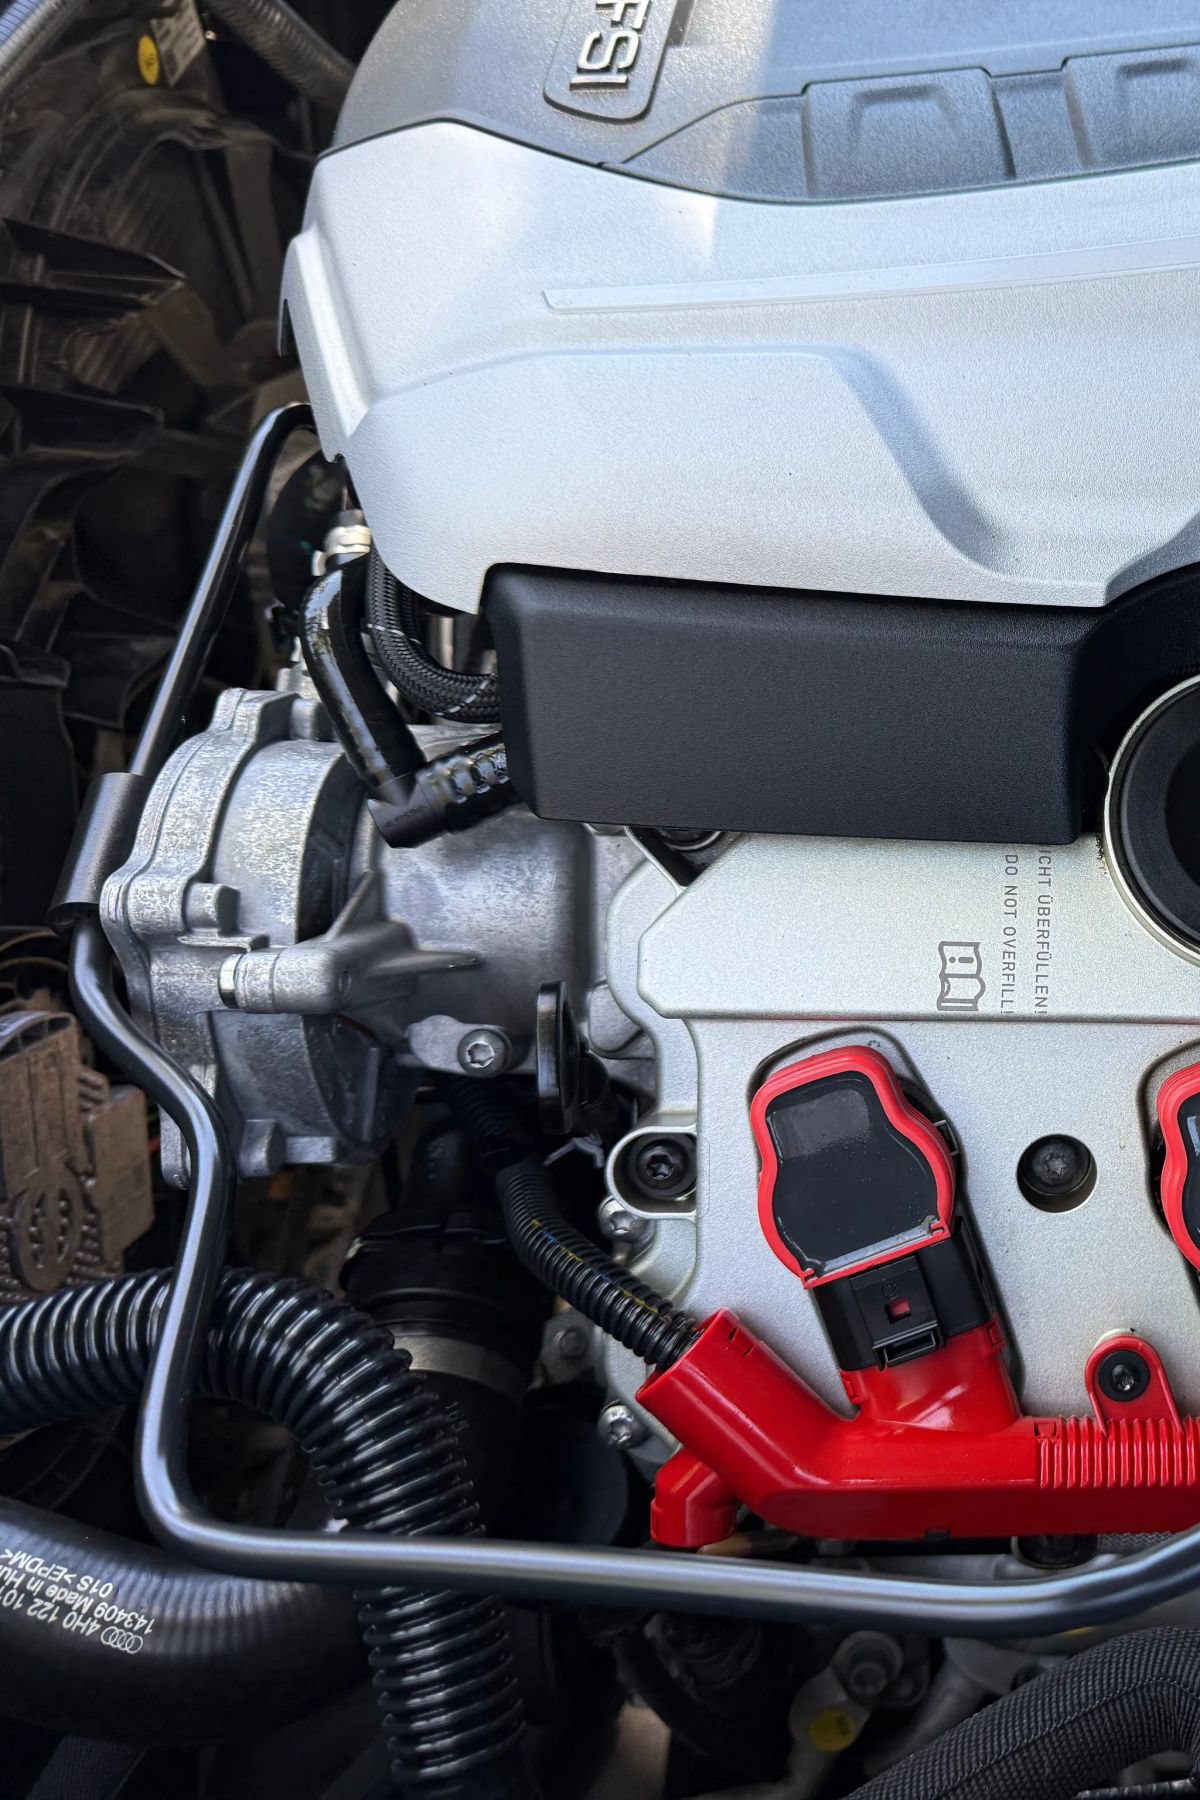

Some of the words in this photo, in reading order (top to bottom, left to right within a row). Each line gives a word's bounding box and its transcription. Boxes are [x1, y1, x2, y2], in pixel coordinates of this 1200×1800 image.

[1005, 854, 1018, 876] DO
[1004, 886, 1018, 918] NOT
[1001, 926, 1017, 1014] OVERFILL!
[1034, 895, 1053, 1014] ÜBERFÜLLEN!
[0, 1564, 25, 1589] Hu
[27, 1598, 60, 1623] 122
[45, 1584, 94, 1614] Made
[93, 1602, 155, 1635] 143409
